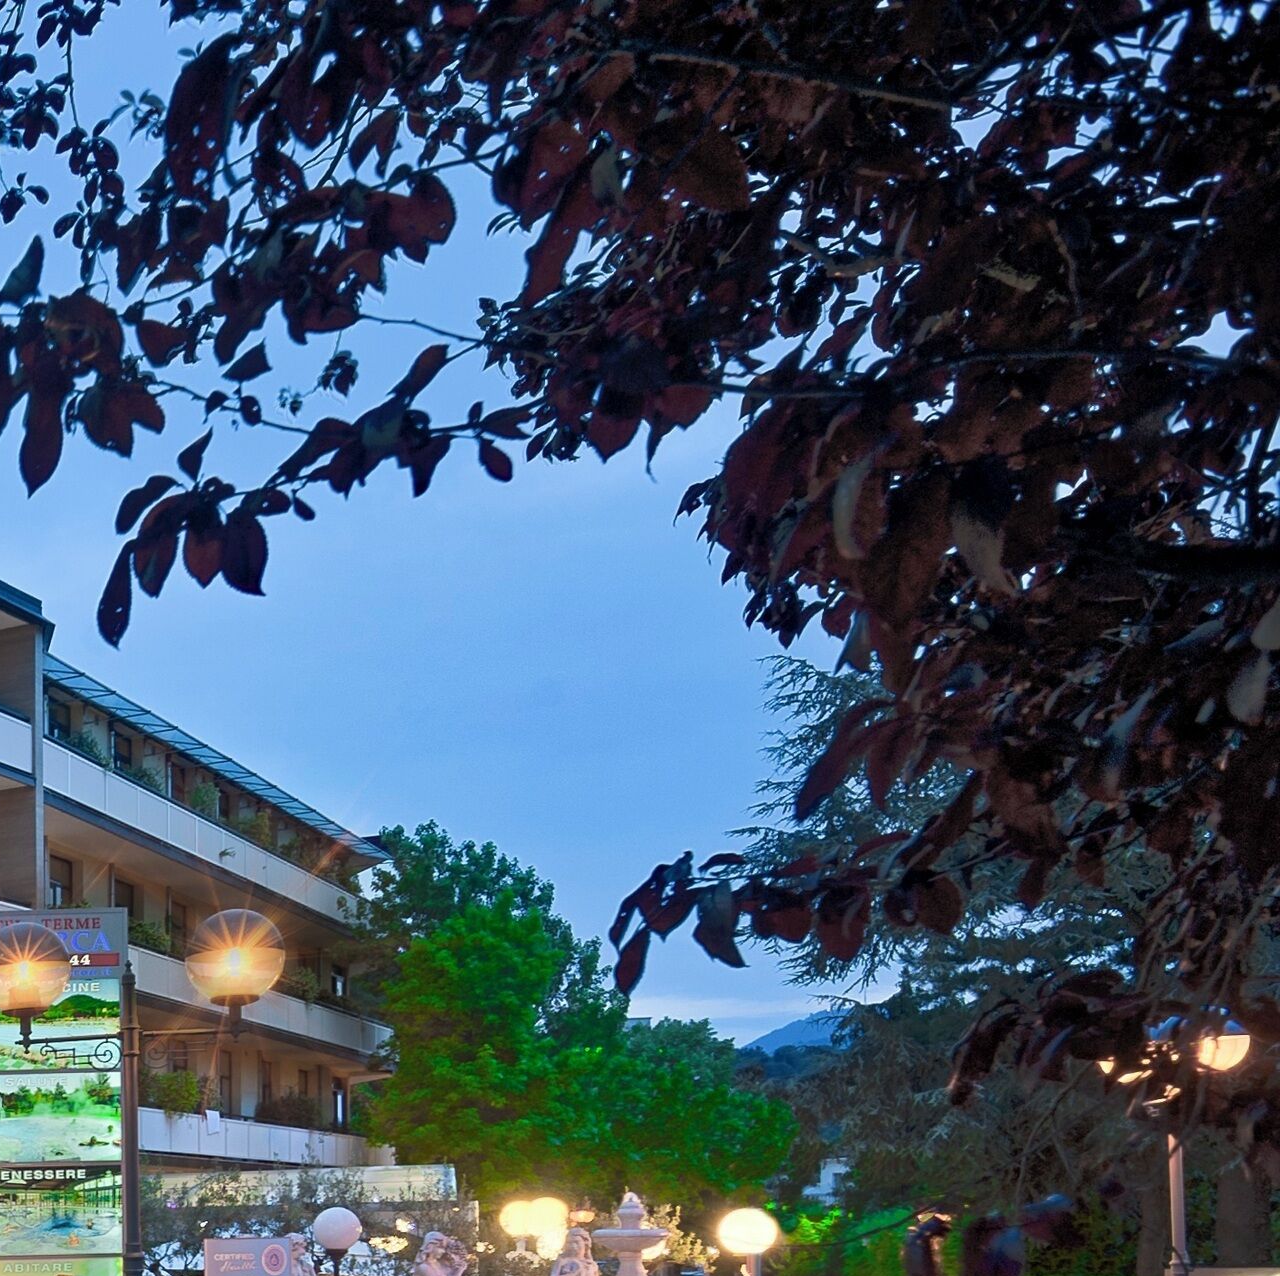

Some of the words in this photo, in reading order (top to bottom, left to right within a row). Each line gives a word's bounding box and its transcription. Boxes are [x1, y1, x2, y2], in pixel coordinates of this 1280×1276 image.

[42, 917, 101, 930] TERME
[5, 1077, 68, 1088] SALUTE
[3, 1262, 73, 1273] ABITARE
